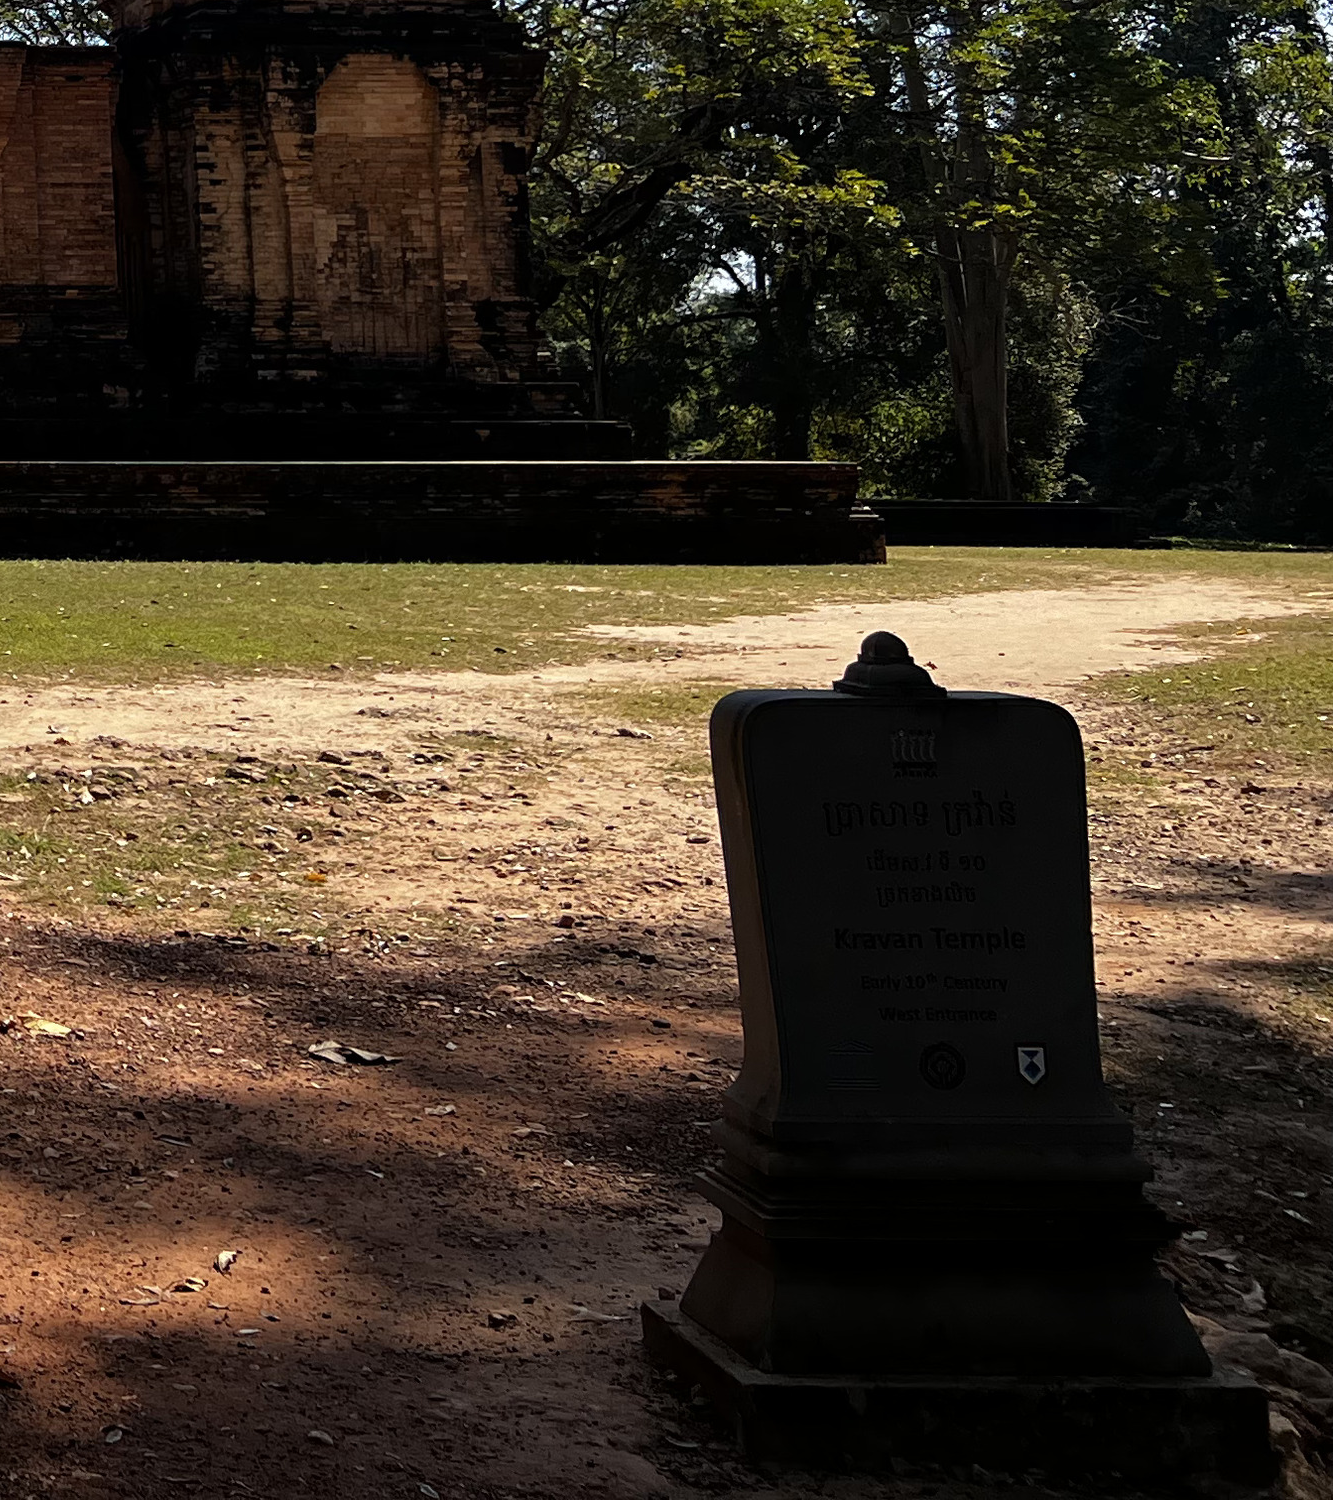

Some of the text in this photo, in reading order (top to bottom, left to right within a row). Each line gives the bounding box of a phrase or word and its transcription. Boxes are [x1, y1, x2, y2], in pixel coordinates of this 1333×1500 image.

[822, 801, 929, 837] ប្រាសាទ
[958, 855, 987, 871] ១០
[834, 925, 1027, 955] Kravan Temple
[861, 972, 1009, 993] Early 10th Century
[878, 1007, 998, 1021] West Entrance
